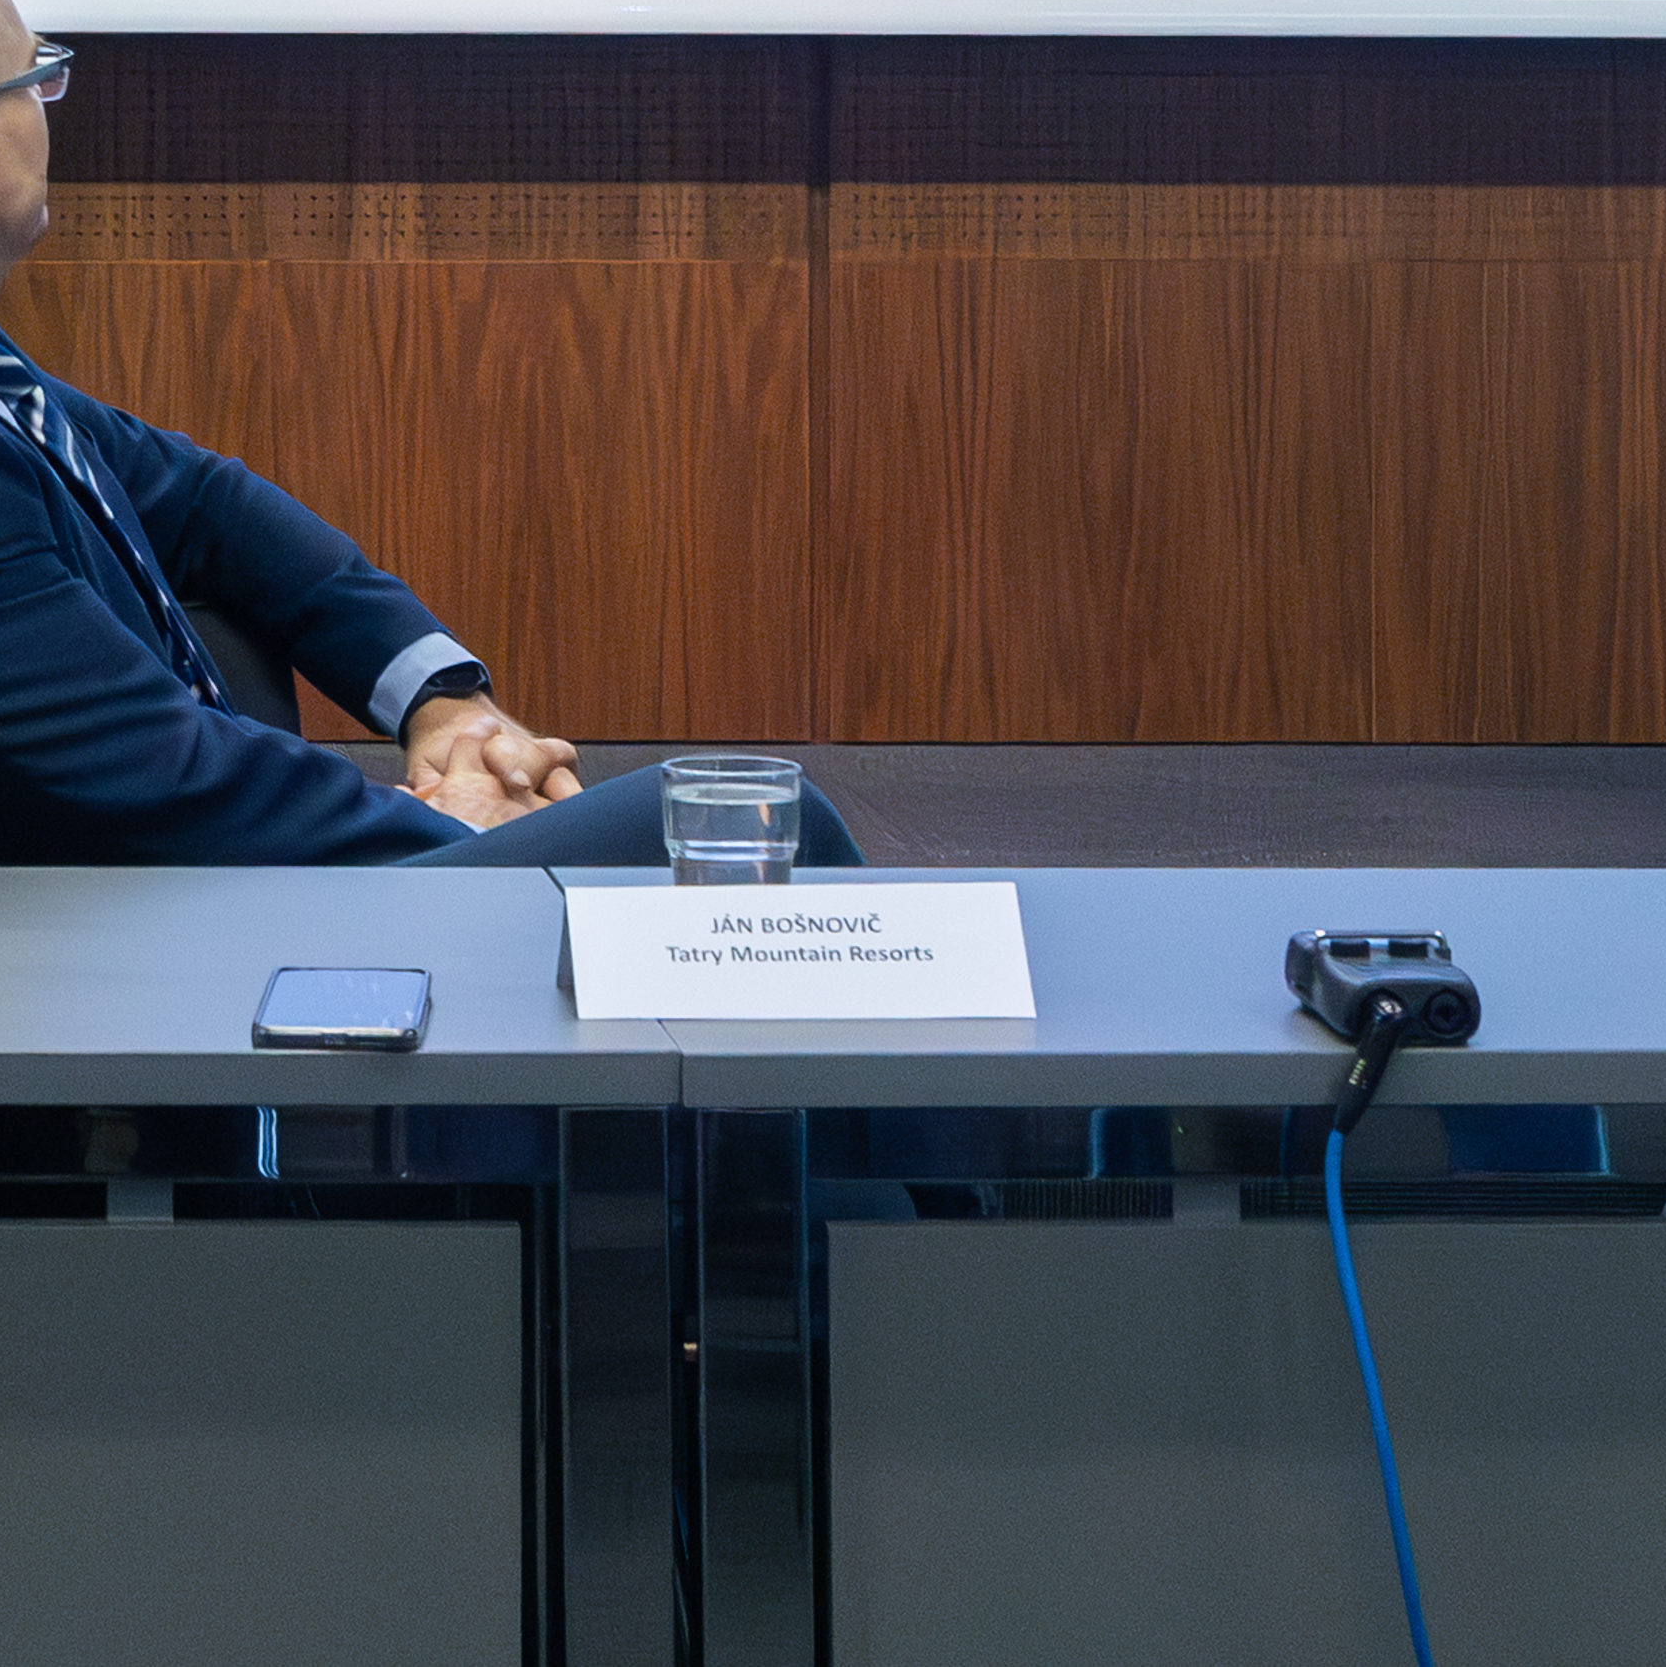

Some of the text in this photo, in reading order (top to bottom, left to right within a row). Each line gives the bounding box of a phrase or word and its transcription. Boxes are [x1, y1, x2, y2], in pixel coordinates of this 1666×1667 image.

[710, 912, 884, 935] JÁN BOŠNOVIČ
[665, 944, 935, 966] Tatry Mountain Resorts
